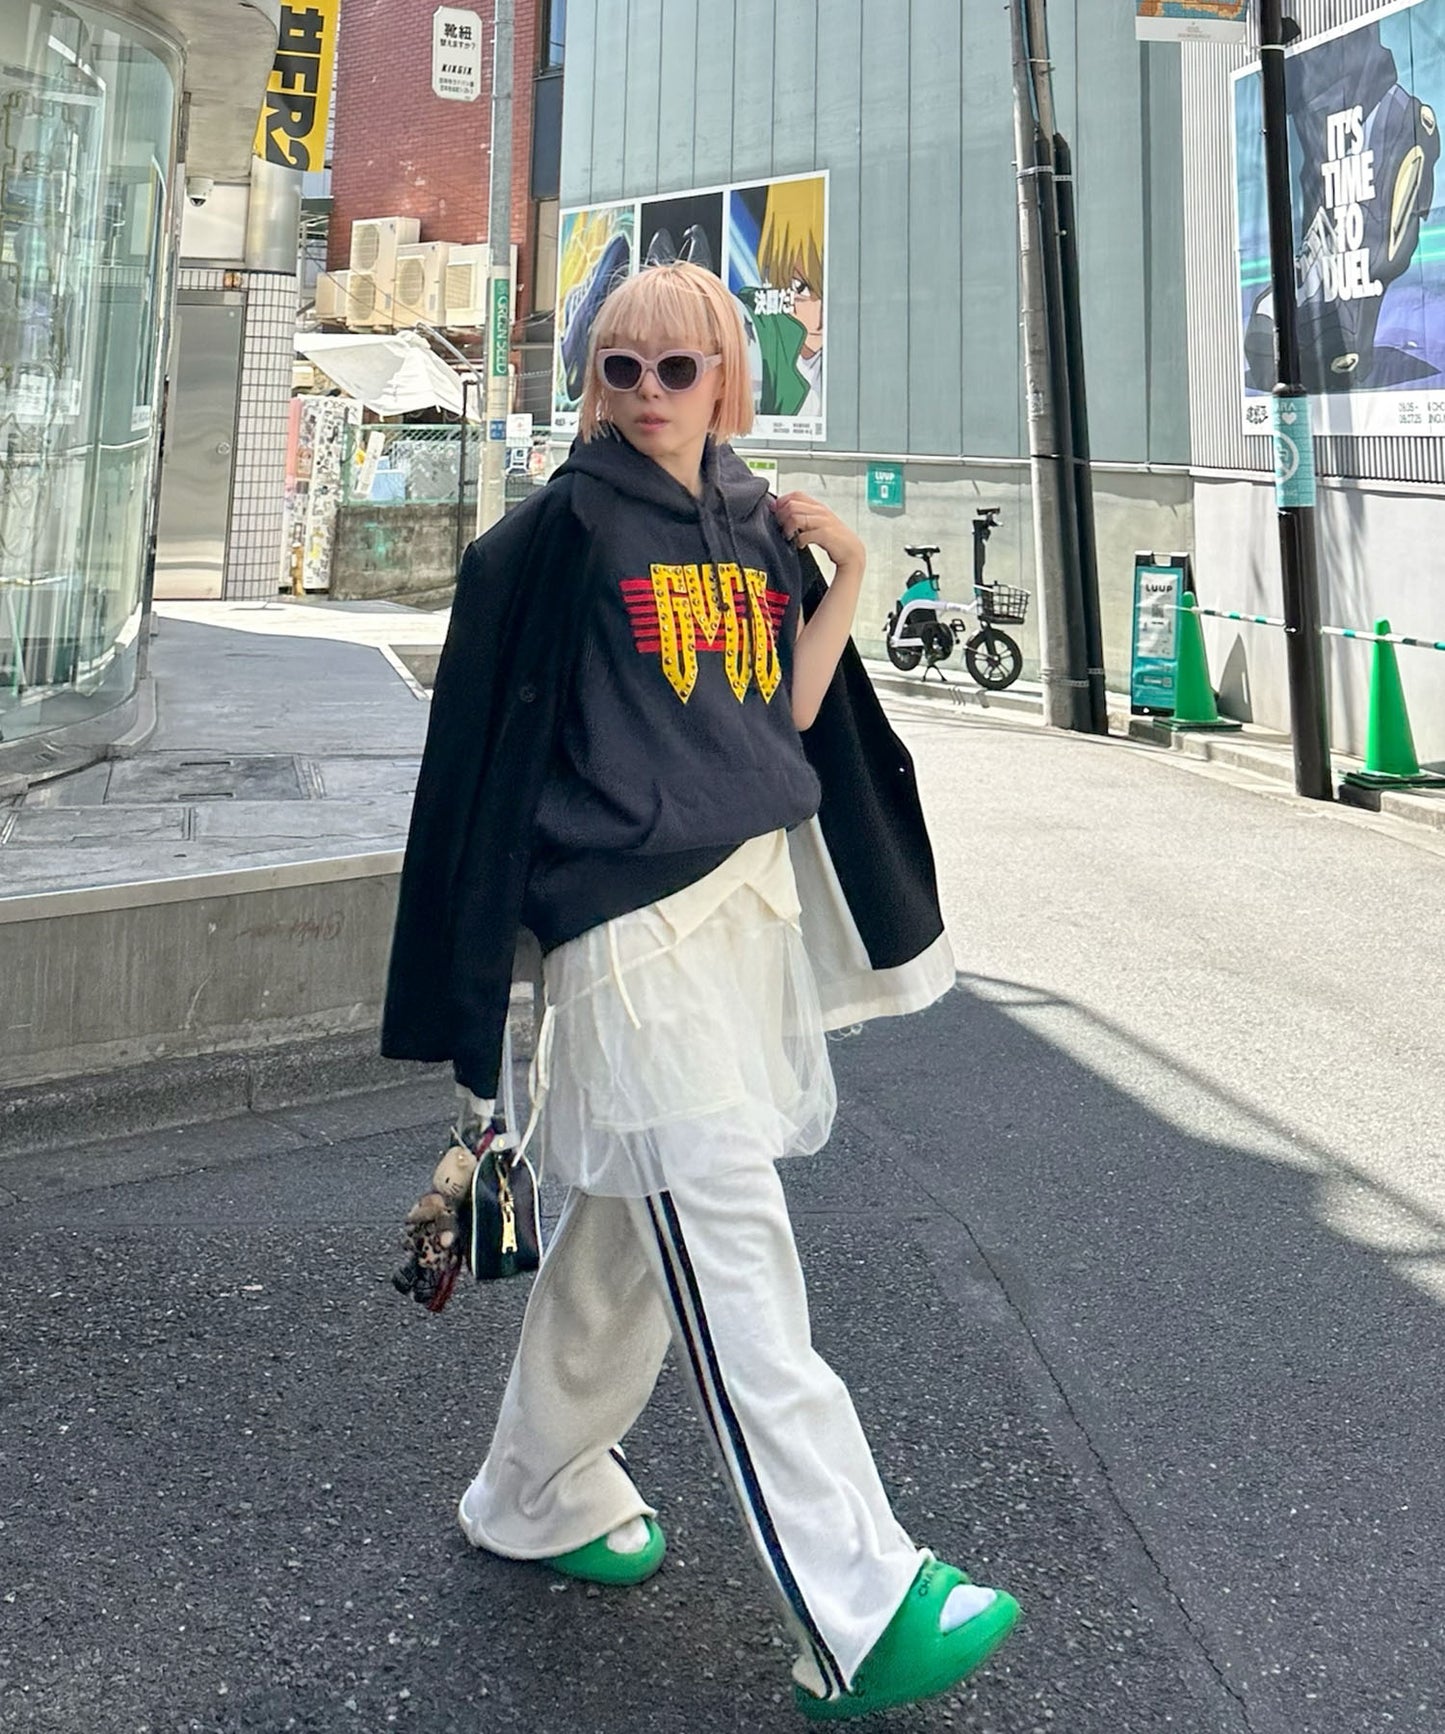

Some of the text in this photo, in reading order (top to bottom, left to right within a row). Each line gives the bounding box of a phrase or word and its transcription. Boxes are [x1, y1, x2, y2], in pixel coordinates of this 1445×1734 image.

[444, 23, 472, 40] 靴紐
[1327, 105, 1364, 162] IT'S
[1321, 150, 1376, 209] TIME
[1333, 202, 1364, 253] TO
[1322, 248, 1383, 302] DUEL.
[496, 296, 509, 340] GREEN
[496, 342, 509, 374] SEED
[1145, 584, 1173, 593] LUUP
